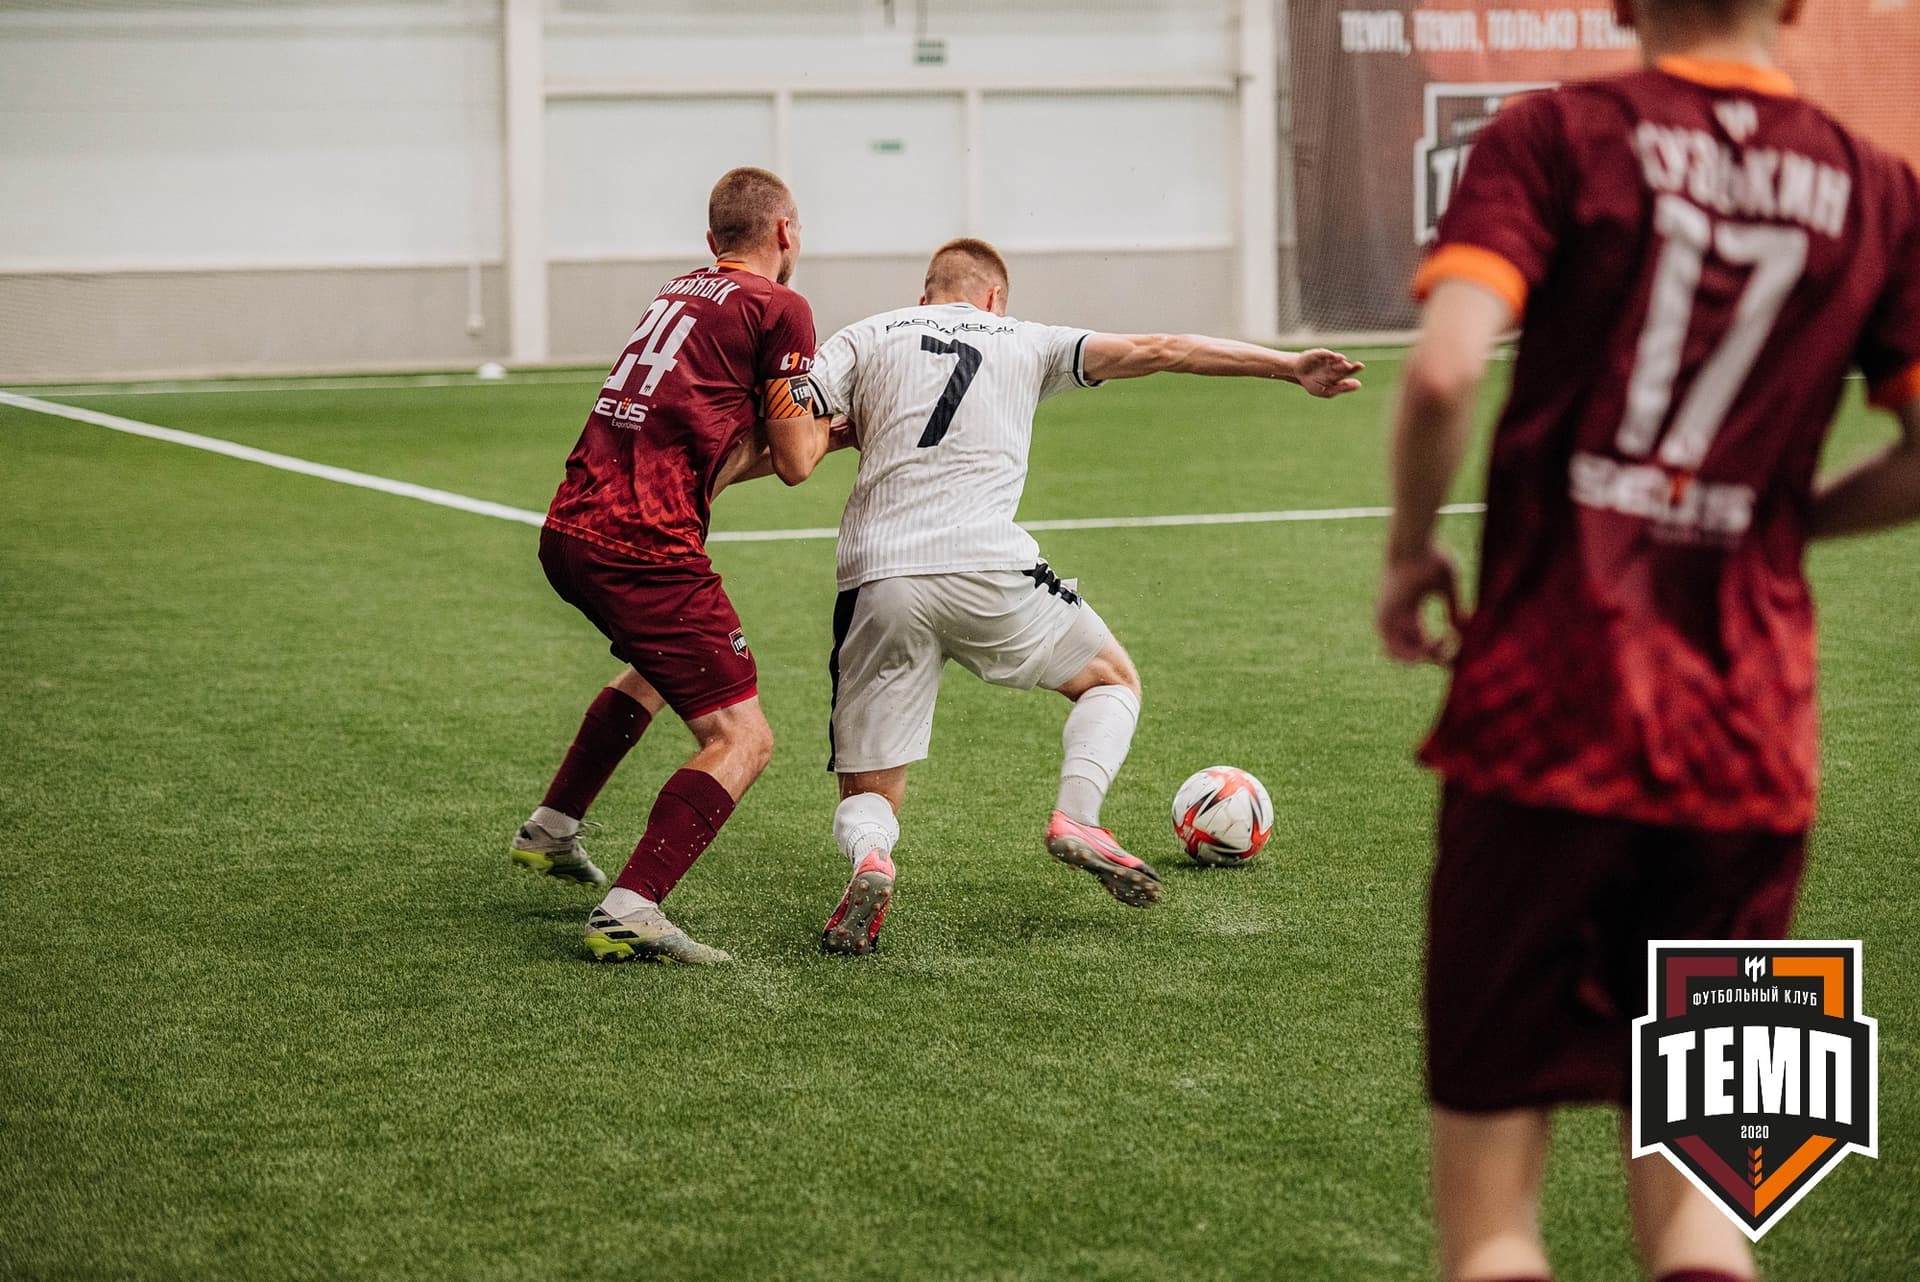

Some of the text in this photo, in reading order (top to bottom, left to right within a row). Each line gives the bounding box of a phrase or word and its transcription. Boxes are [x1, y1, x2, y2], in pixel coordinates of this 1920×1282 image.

[602, 299, 698, 397] 24
[1616, 194, 1808, 467] 17
[917, 335, 983, 448] 7
